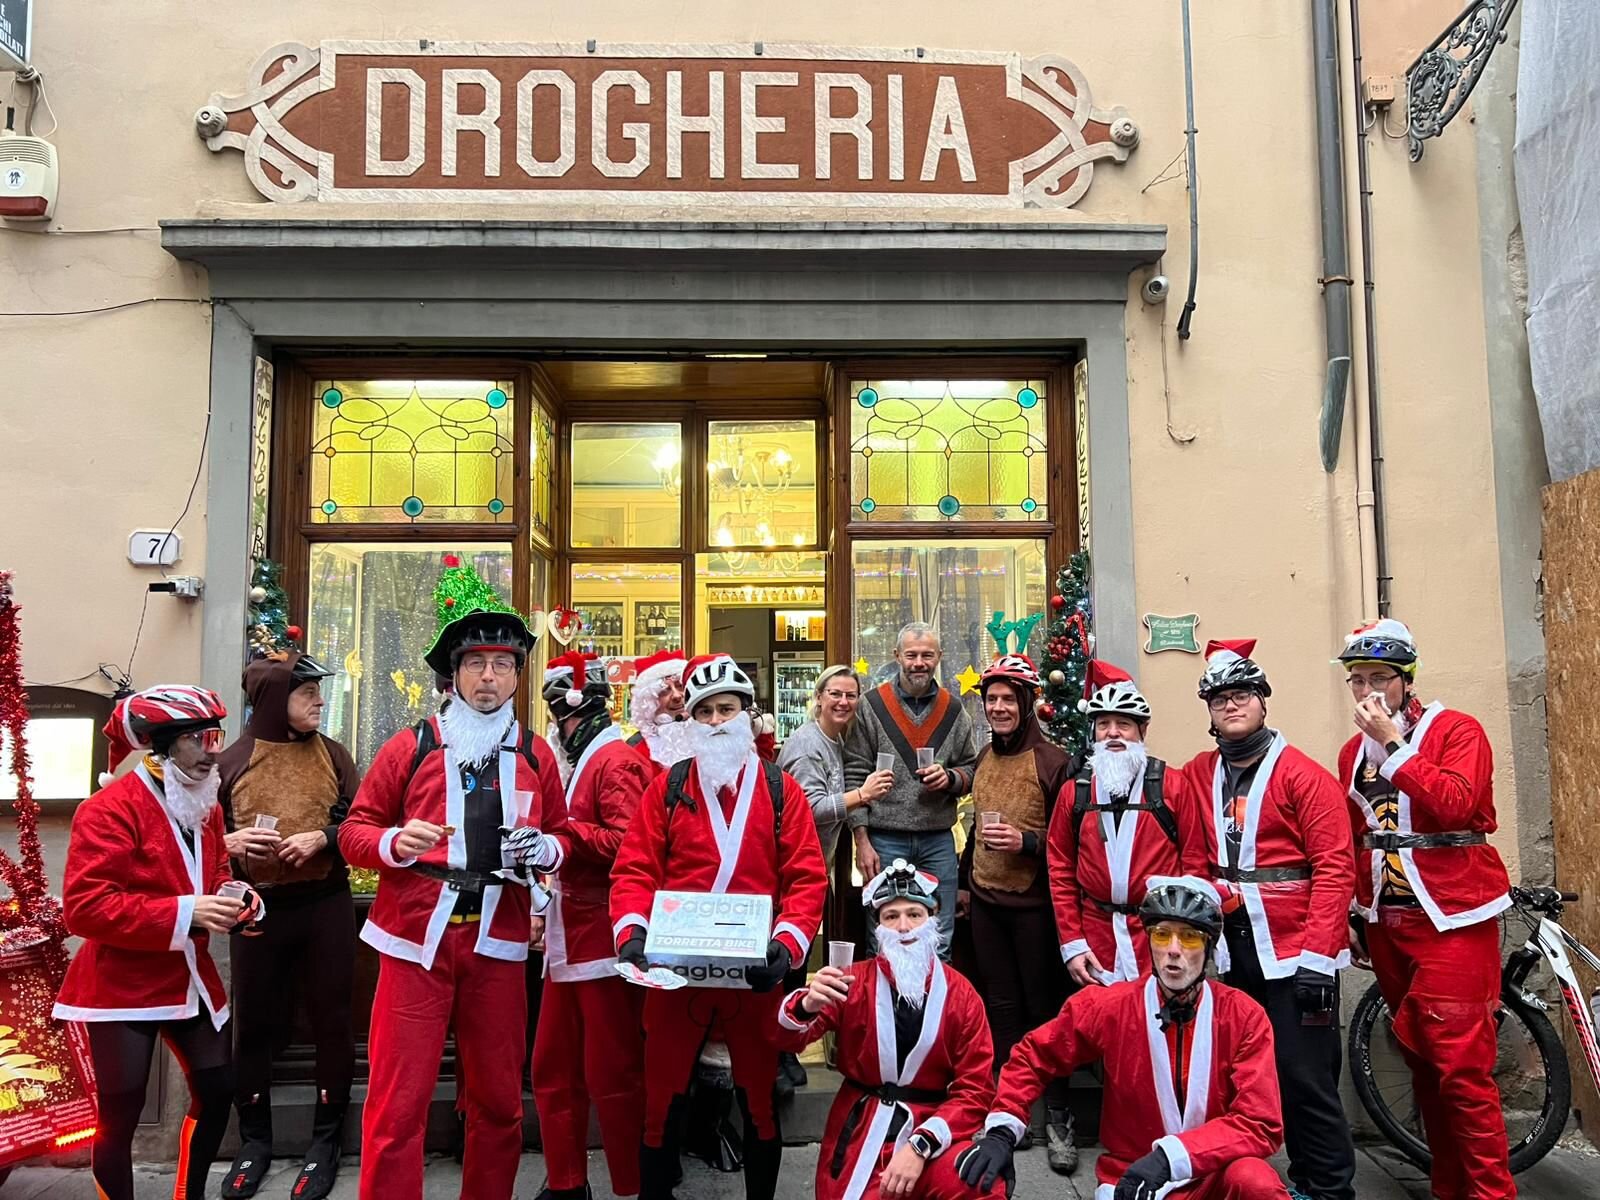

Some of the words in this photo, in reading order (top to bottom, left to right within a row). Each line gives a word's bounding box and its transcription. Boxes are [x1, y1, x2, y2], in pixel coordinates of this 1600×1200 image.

[364, 67, 979, 184] DROGHERIA
[148, 537, 161, 559] 7
[655, 935, 721, 948] TORRETTA
[725, 939, 756, 949] BIKE
